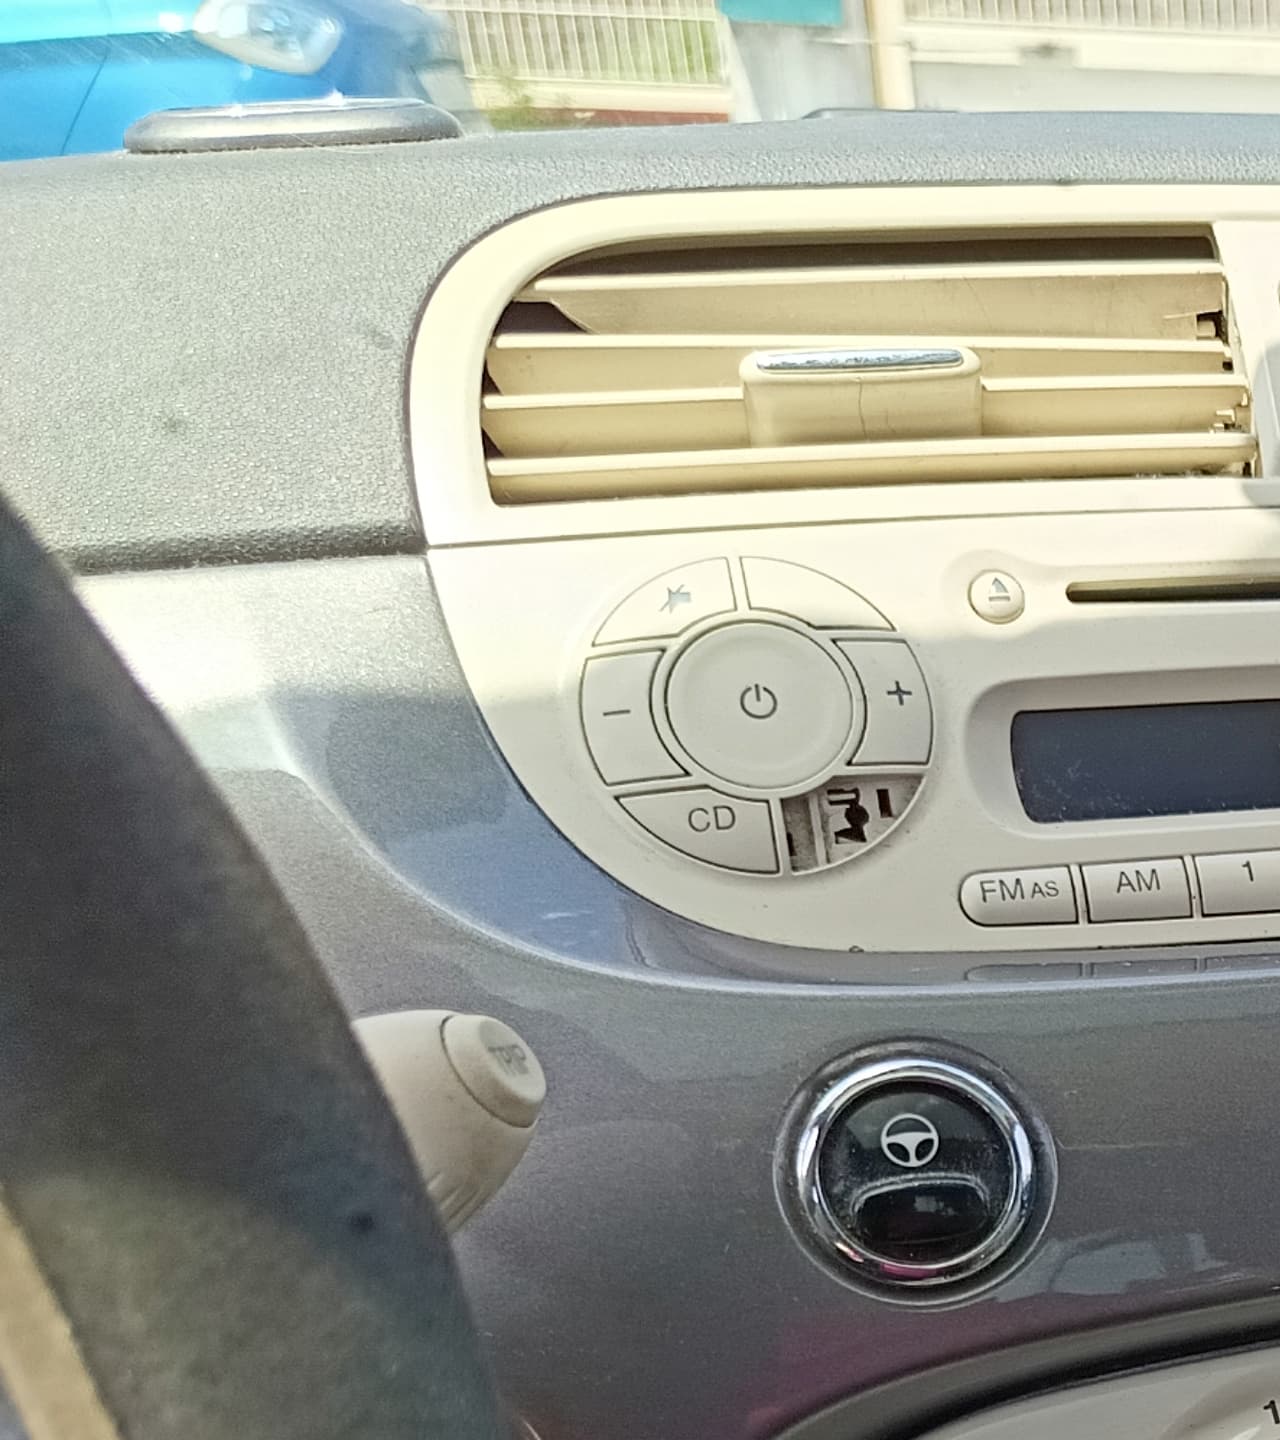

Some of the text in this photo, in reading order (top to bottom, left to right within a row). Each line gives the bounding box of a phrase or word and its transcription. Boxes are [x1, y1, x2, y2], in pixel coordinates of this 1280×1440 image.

[687, 804, 737, 833] CD
[1116, 868, 1161, 894] AM
[1242, 860, 1255, 882] 1
[980, 877, 1059, 903] FM AS
[1263, 1400, 1280, 1425] 1
